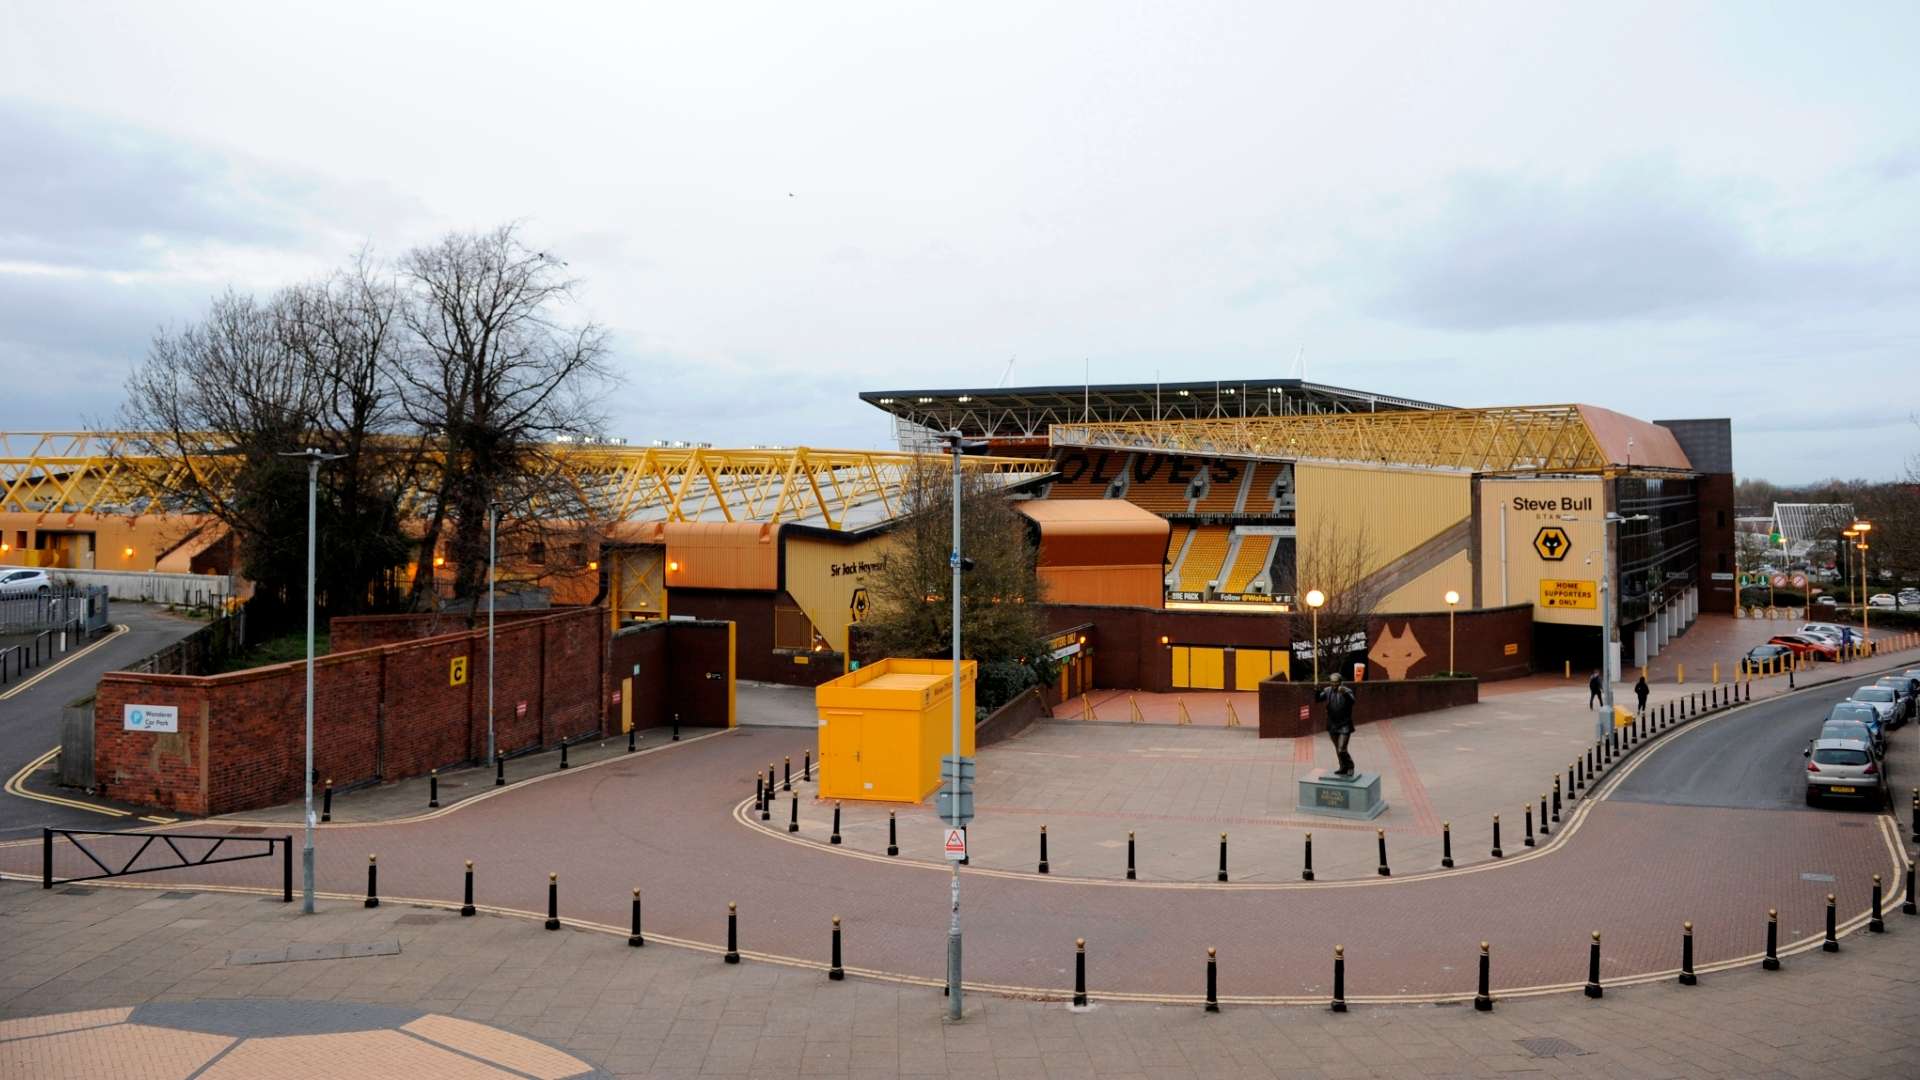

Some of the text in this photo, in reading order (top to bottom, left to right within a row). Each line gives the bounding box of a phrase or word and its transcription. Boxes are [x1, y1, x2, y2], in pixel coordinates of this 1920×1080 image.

[1512, 496, 1592, 511] Steve Bull
[831, 564, 840, 577] Sir
[842, 562, 857, 575] Jack
[1221, 593, 1272, 602] Follow @Wolves
[1544, 590, 1592, 598] SUPPORTERS
[455, 666, 462, 681] C
